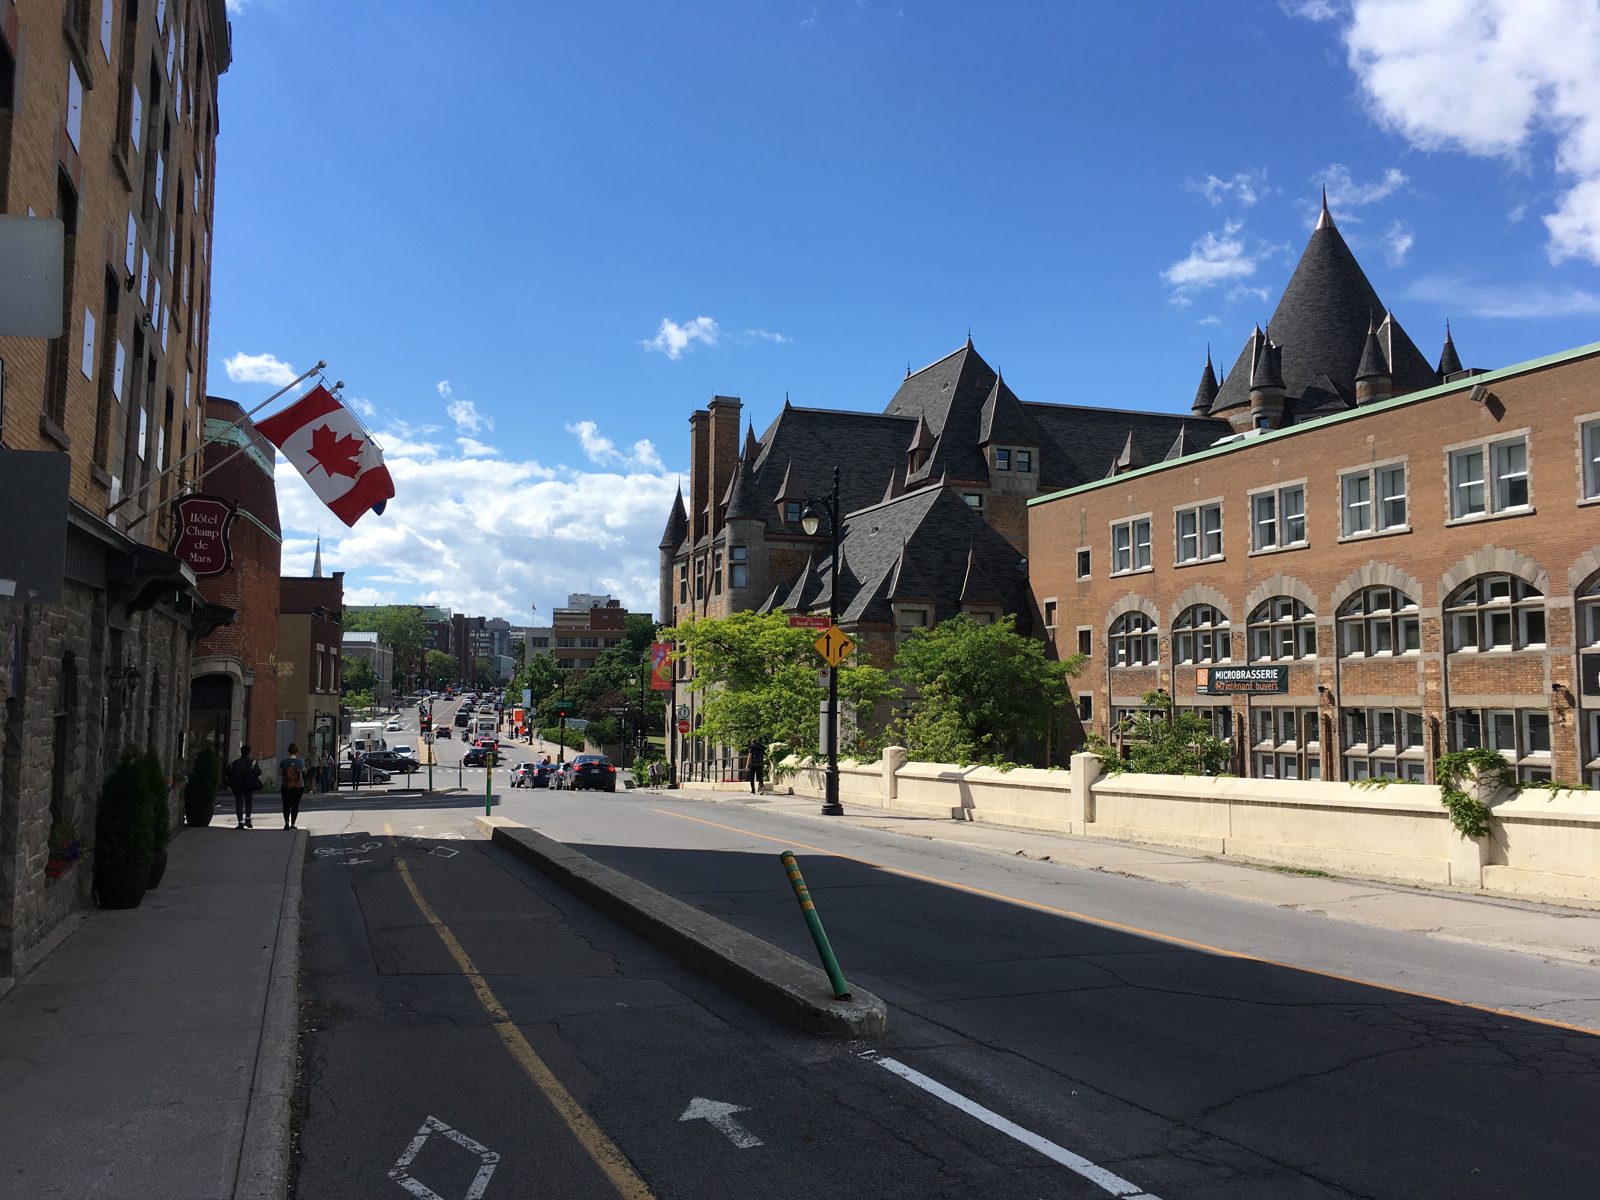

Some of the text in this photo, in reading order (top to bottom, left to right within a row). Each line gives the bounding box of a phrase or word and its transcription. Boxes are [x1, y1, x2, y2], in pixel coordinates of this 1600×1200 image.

[190, 513, 218, 524] Hôtel
[186, 526, 219, 540] Champ
[194, 540, 209, 550] de
[189, 552, 212, 563] Mars
[1215, 669, 1278, 679] MICROBRASSERIE
